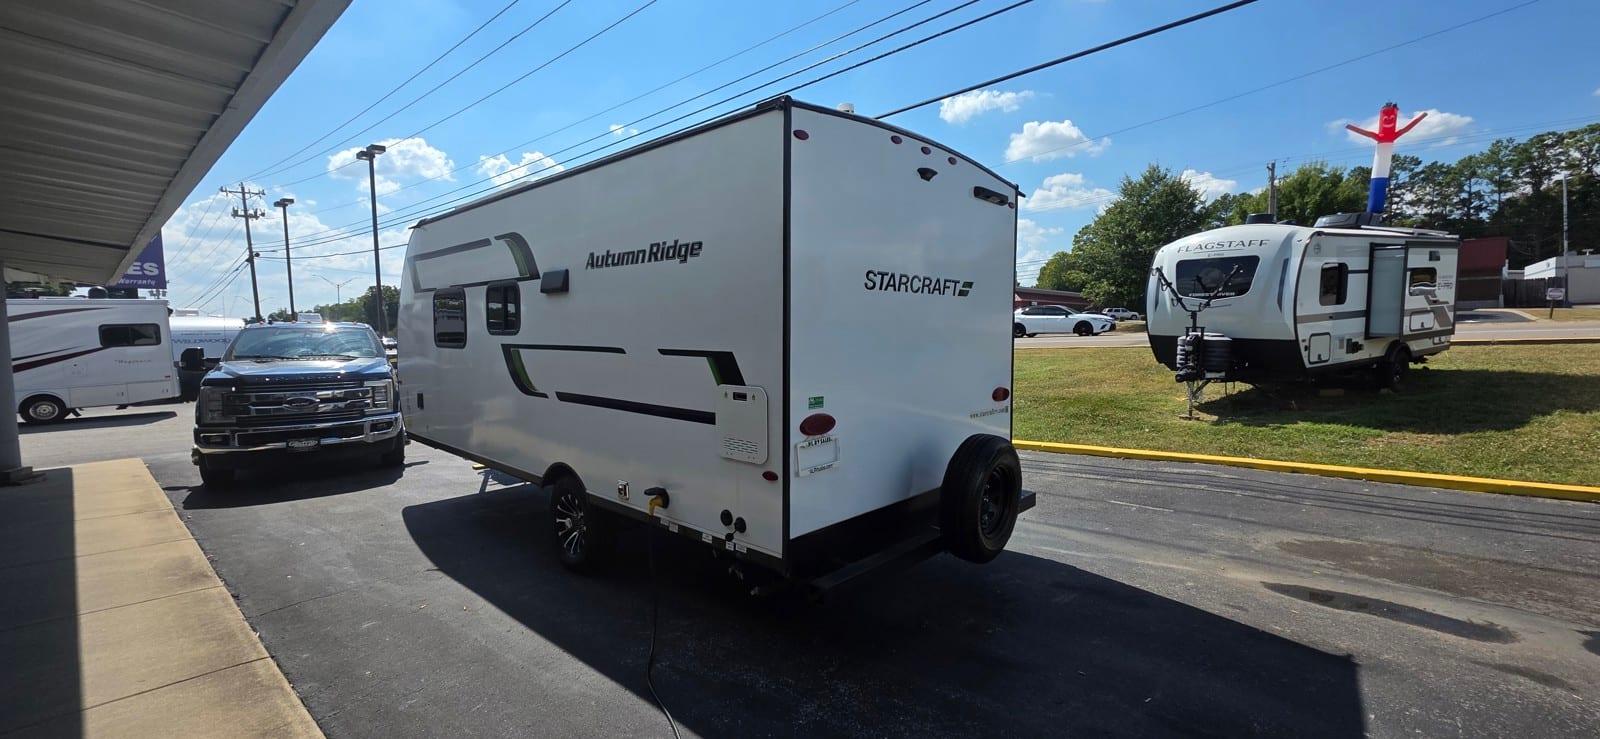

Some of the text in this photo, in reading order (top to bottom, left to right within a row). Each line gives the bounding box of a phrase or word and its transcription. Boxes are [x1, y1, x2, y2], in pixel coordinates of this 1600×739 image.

[585, 238, 703, 270] Autumn Ridge
[1177, 240, 1270, 253] FLAGSTAFF
[864, 269, 960, 297] STARCRAFT
